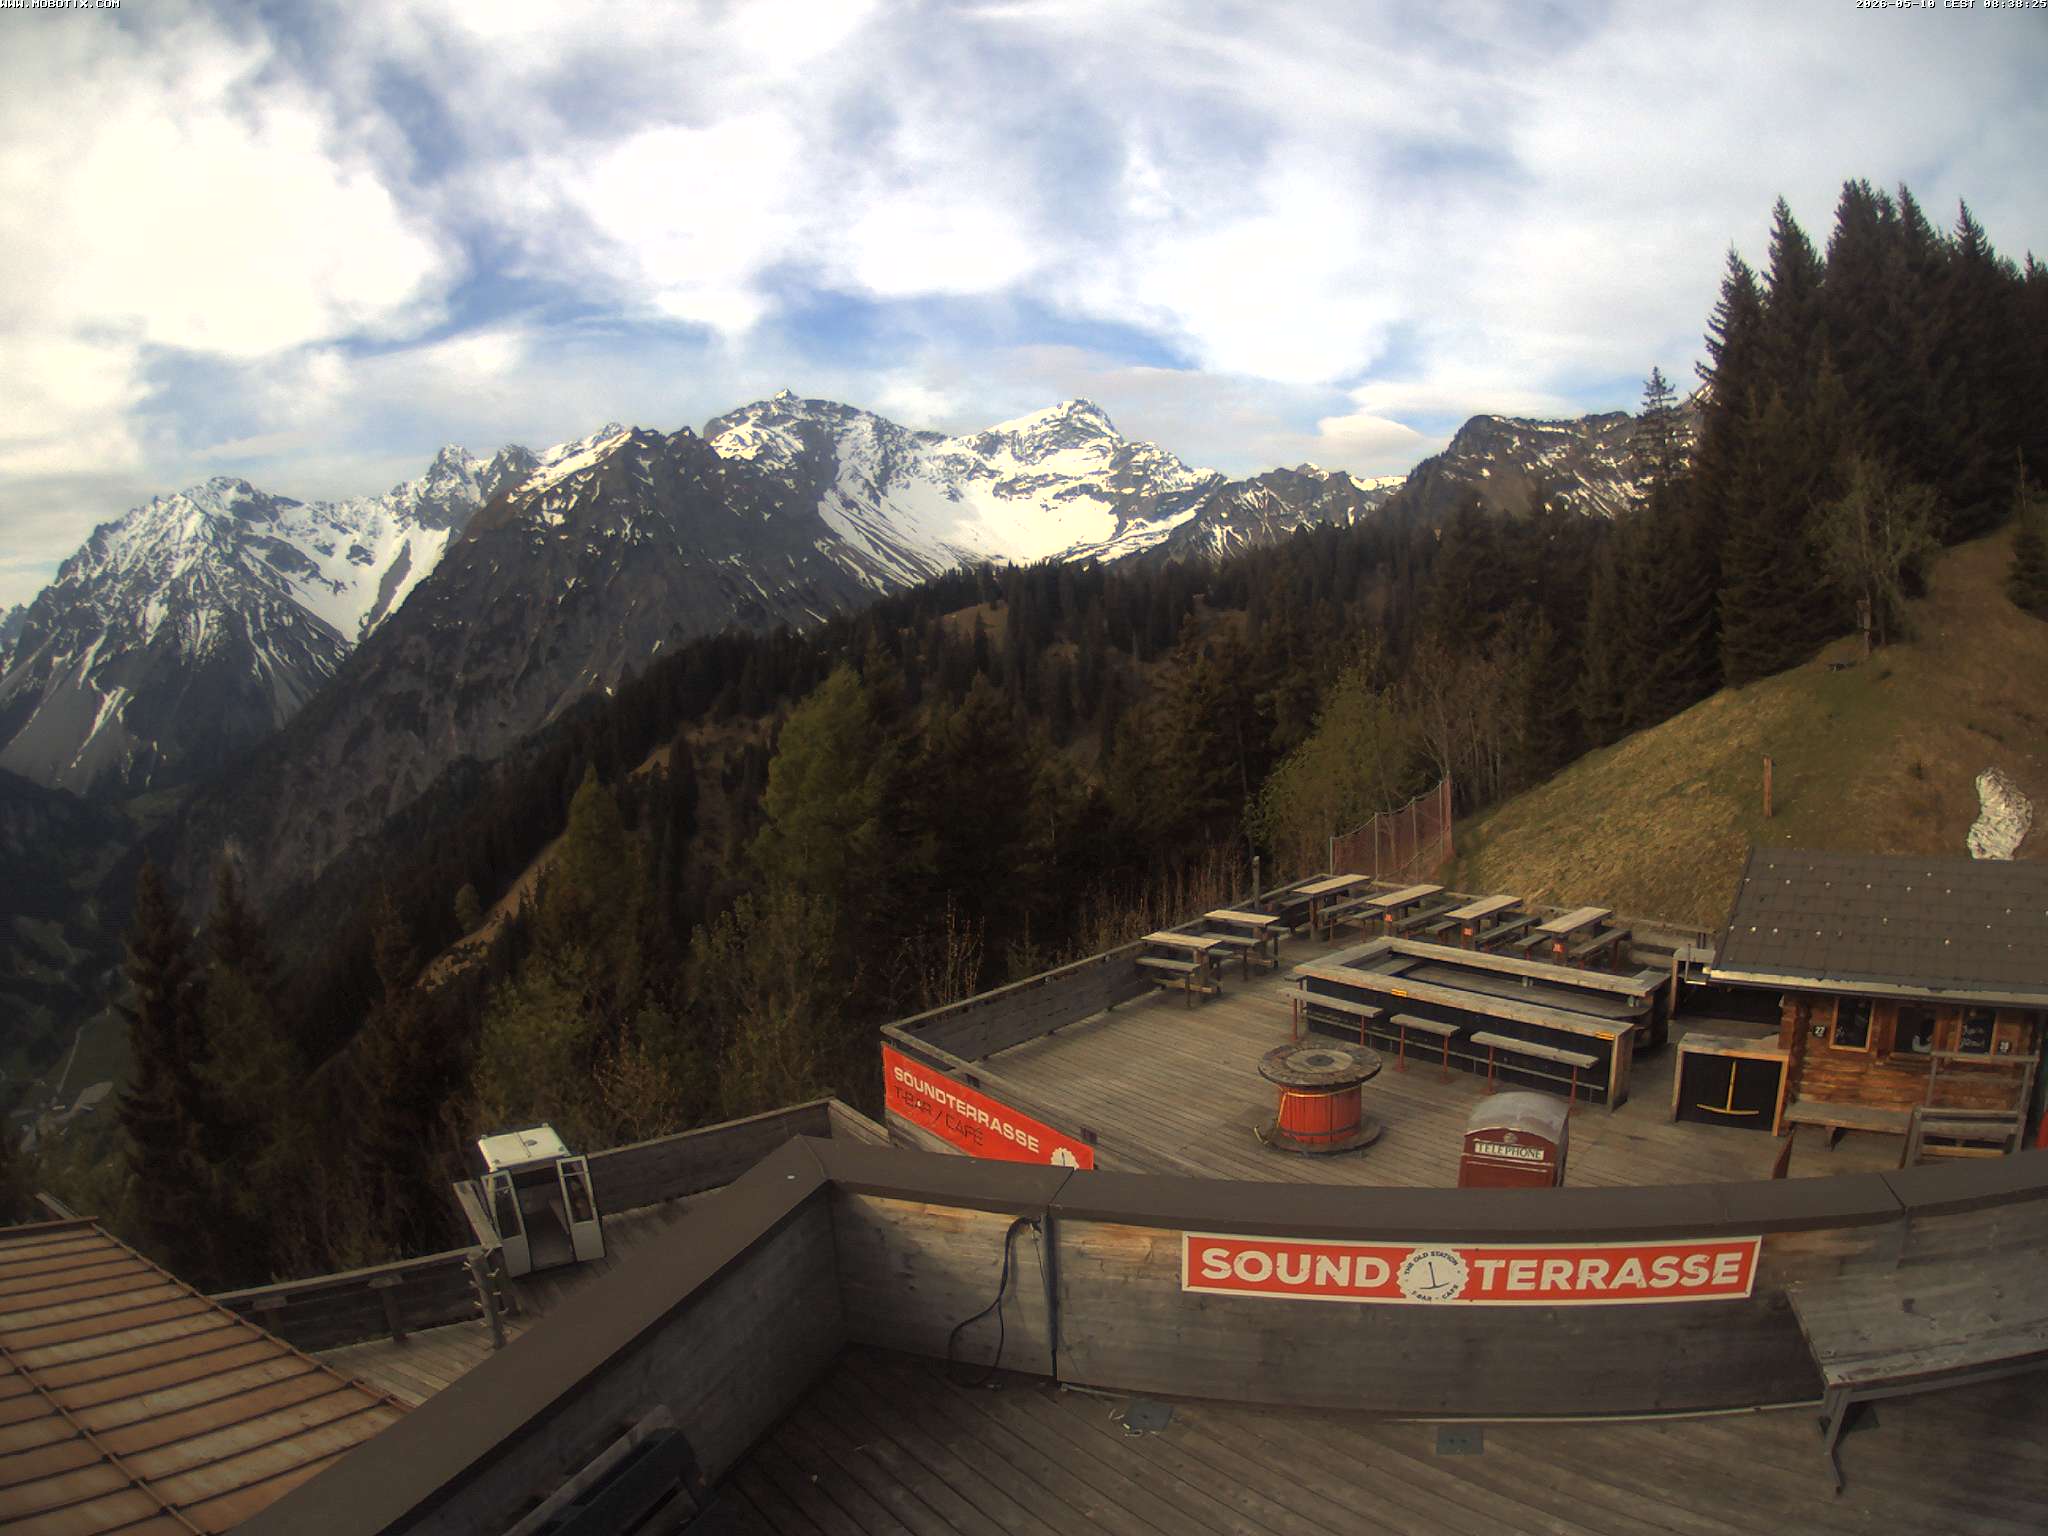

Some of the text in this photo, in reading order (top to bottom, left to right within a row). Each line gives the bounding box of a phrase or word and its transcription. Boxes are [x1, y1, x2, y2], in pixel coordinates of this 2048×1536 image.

[894, 1066, 1039, 1152] SOUNDTERRASSE
[1477, 1143, 1542, 1159] TELEPHONE
[1201, 1247, 1743, 1291] SOUND TERRASSE
[1413, 1252, 1429, 1263] OLD
